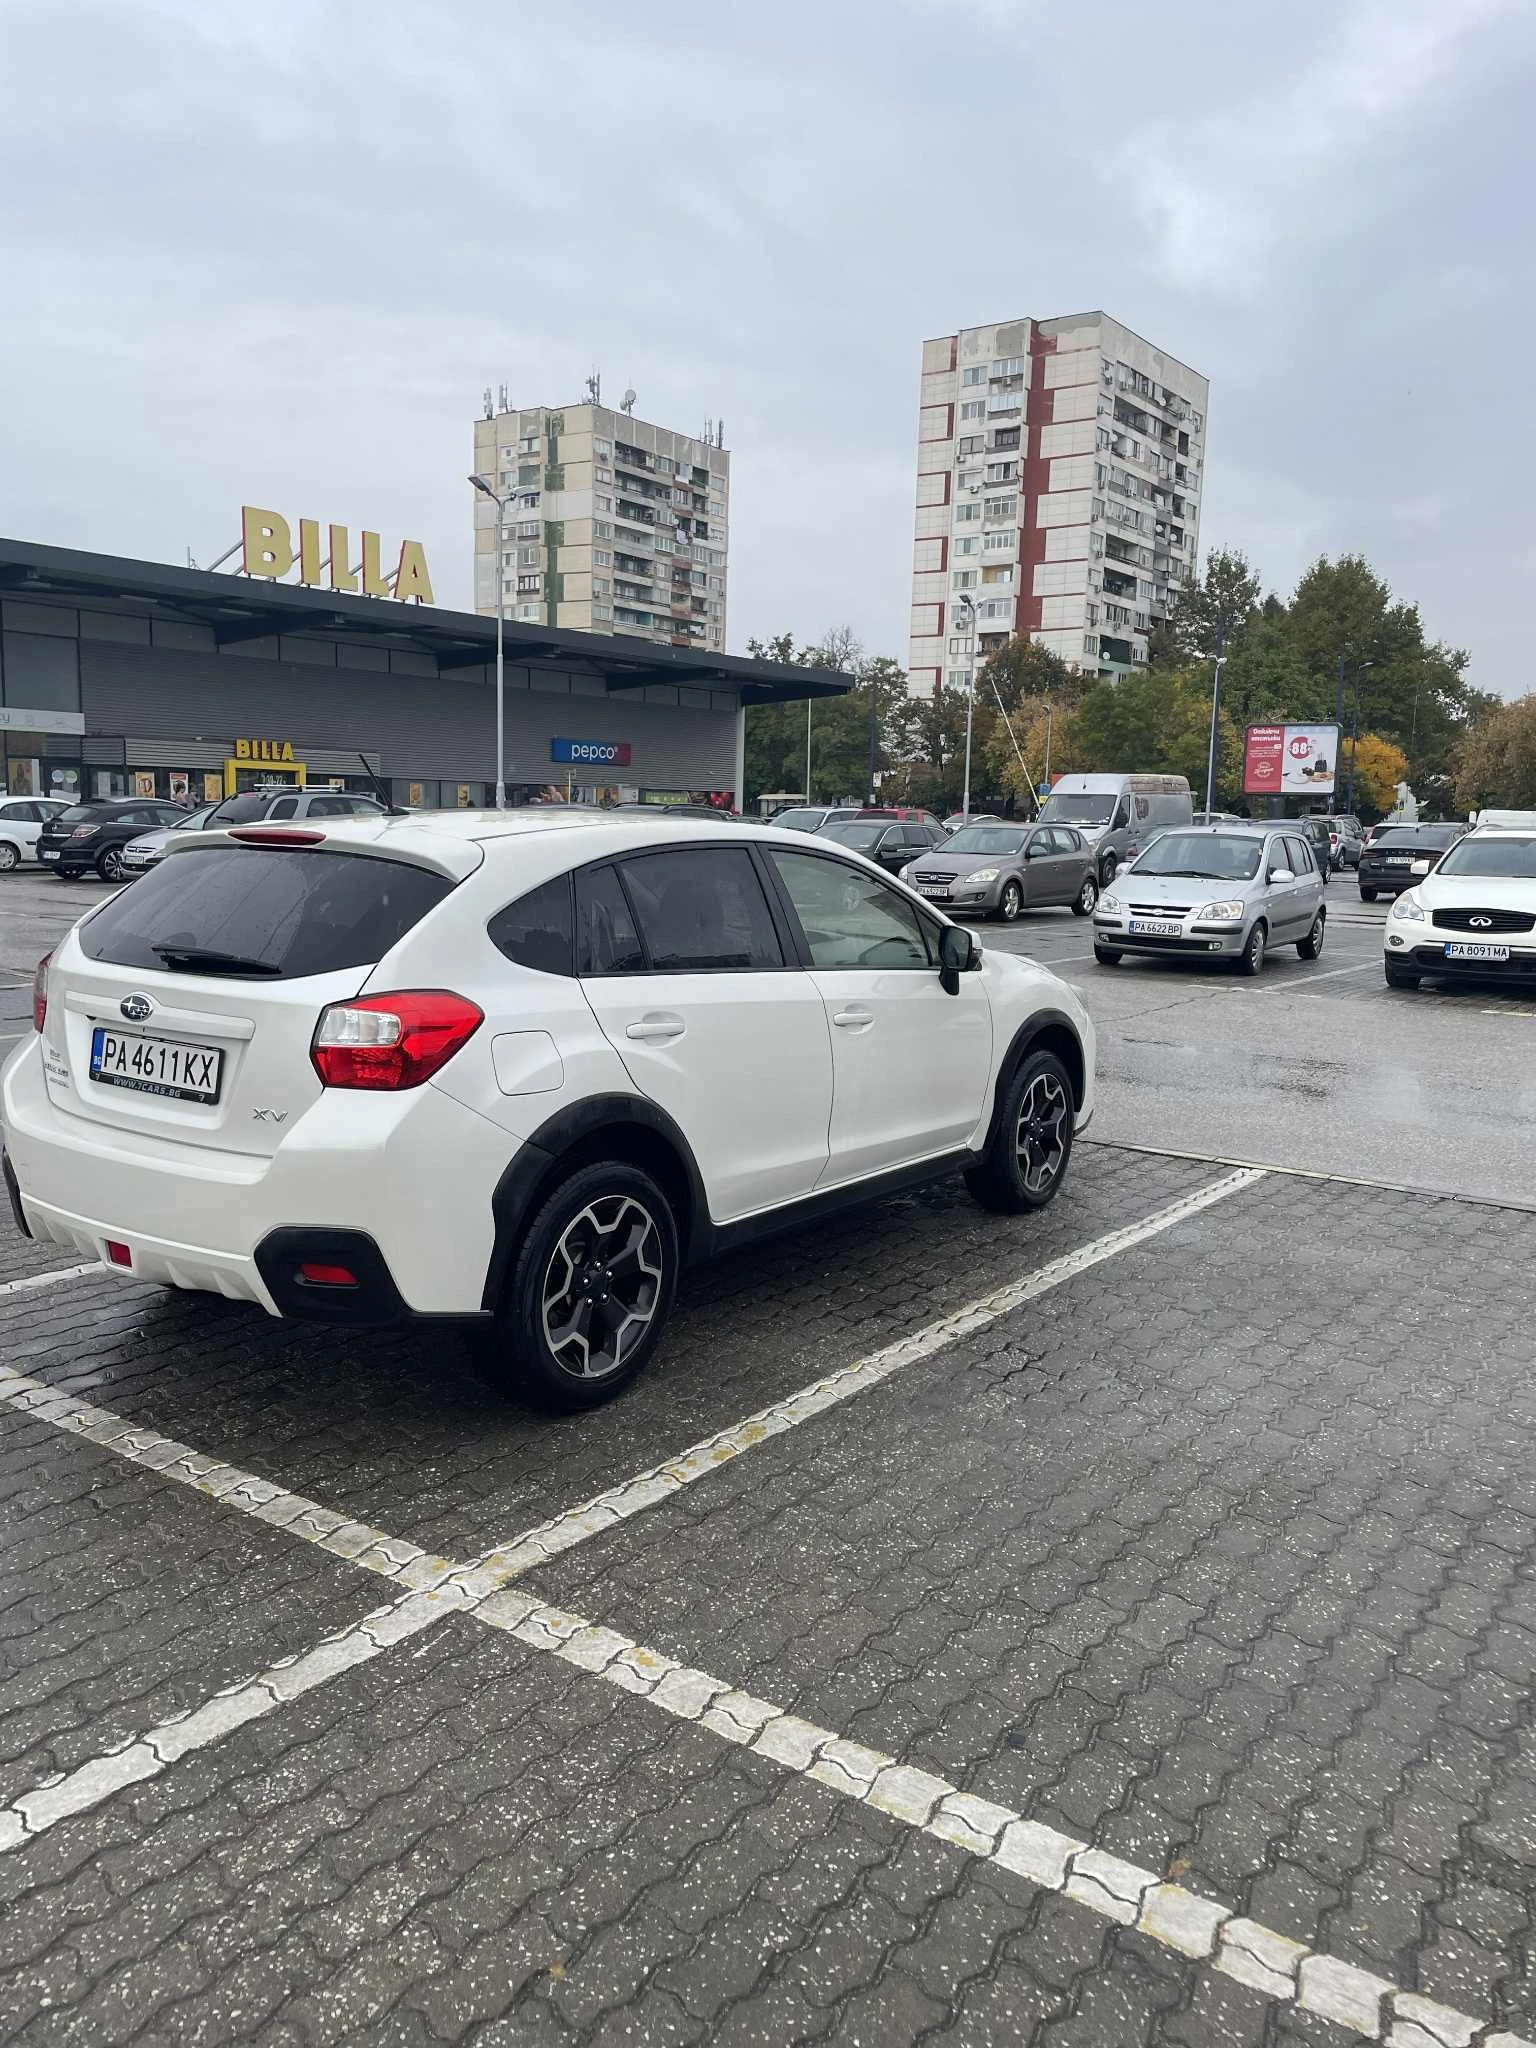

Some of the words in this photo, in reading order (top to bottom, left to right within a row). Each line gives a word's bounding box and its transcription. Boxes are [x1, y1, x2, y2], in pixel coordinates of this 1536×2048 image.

[242, 505, 435, 604] BILLA
[236, 738, 295, 760] BILLA
[571, 744, 615, 760] pepco
[113, 1076, 181, 1098] WWW.7CARS.BG
[253, 1108, 289, 1122] XV
